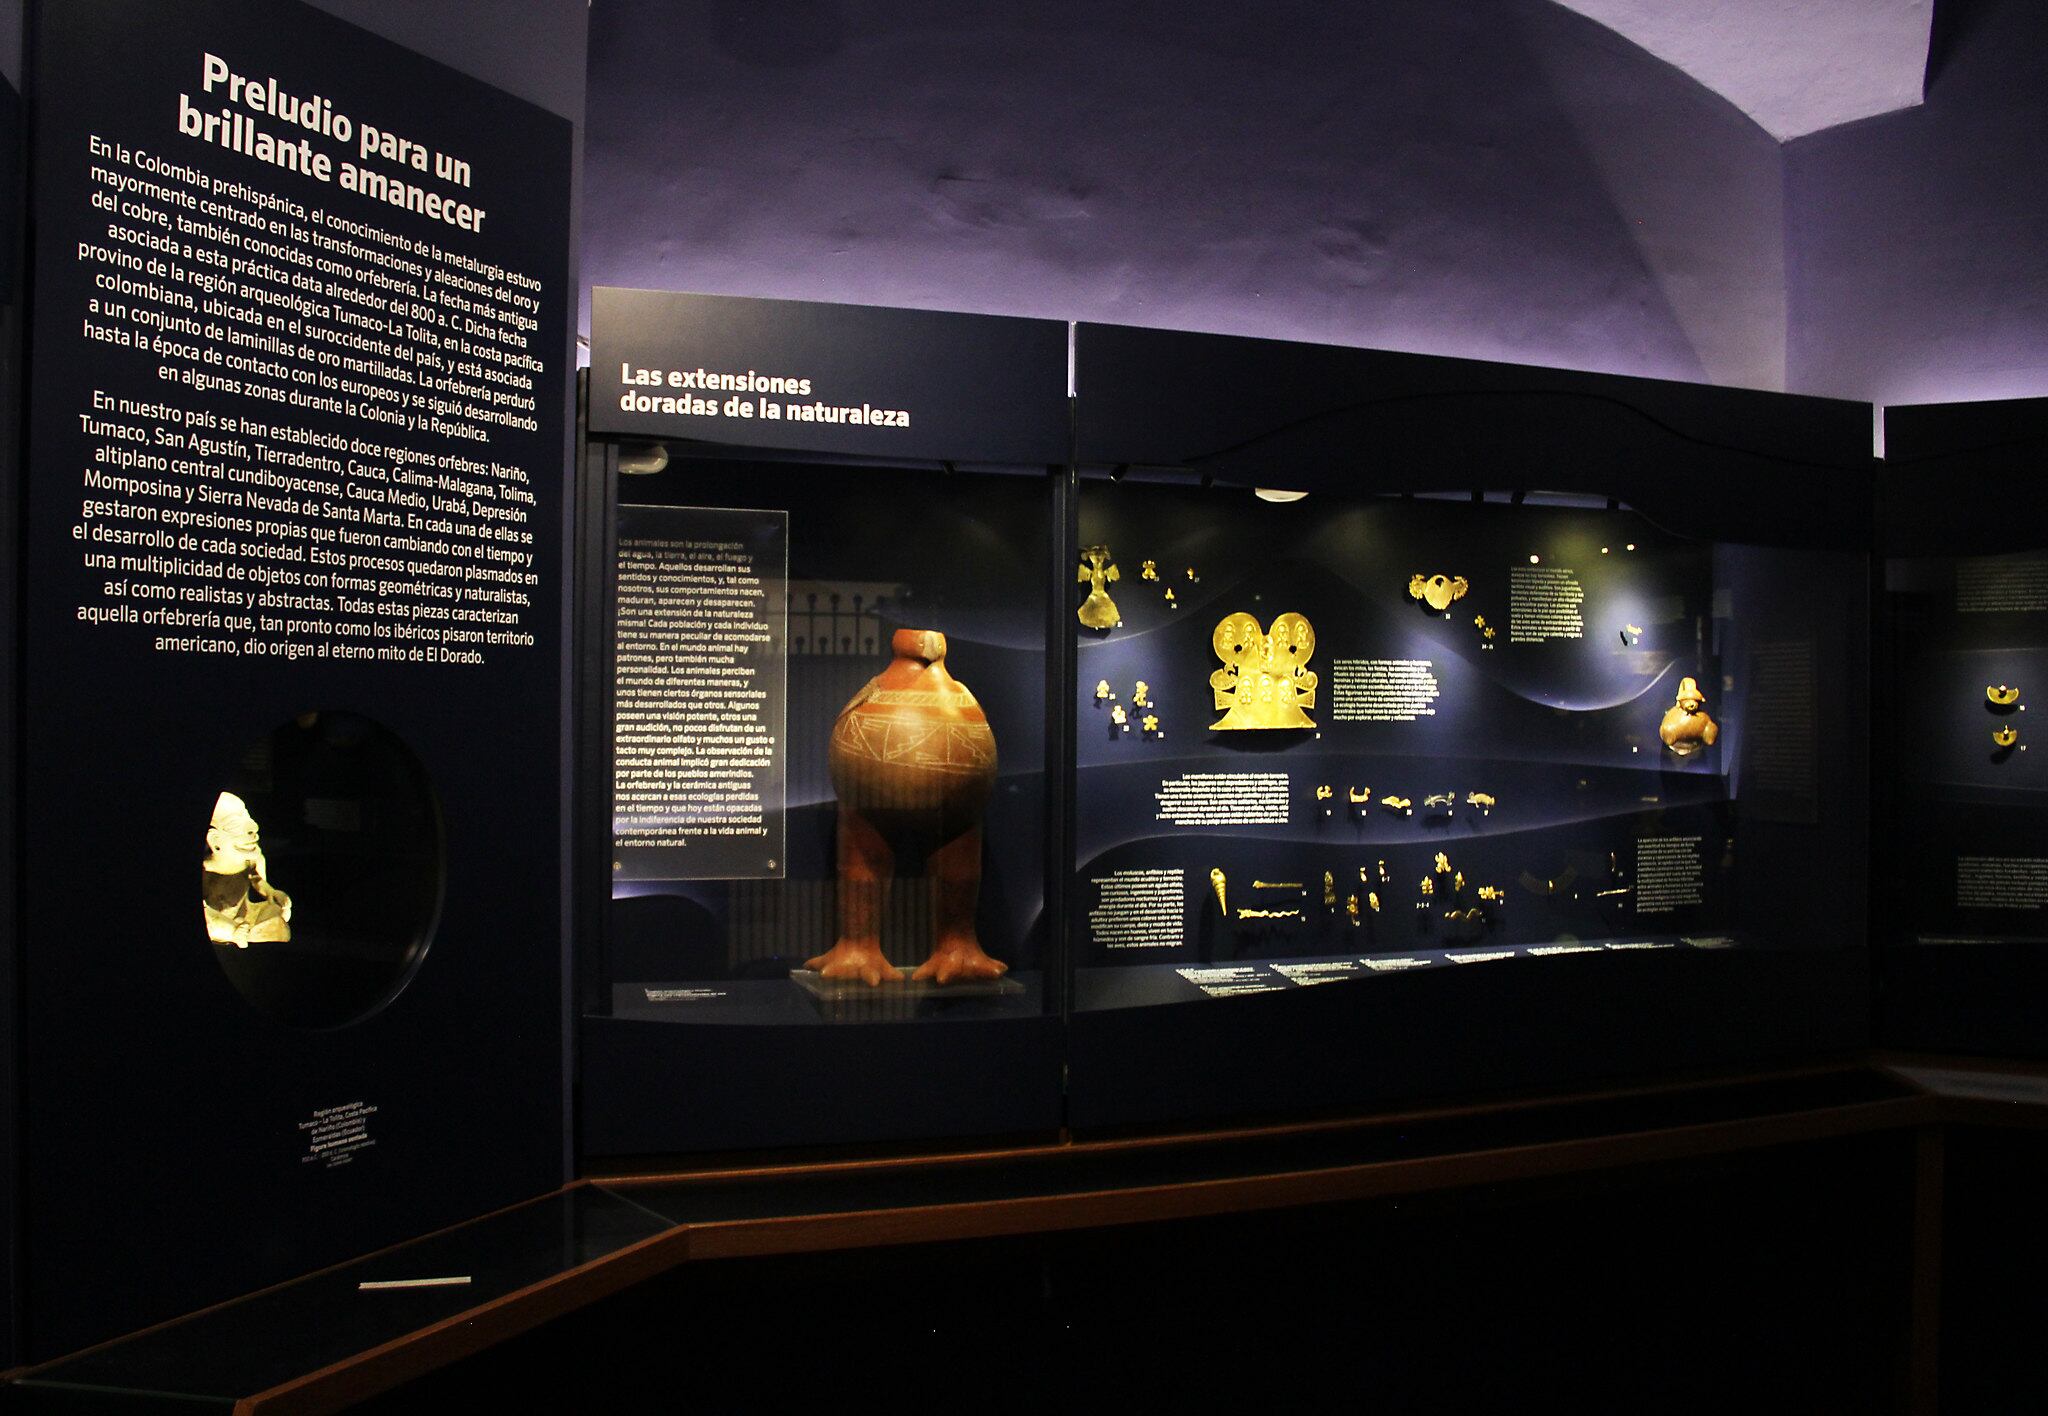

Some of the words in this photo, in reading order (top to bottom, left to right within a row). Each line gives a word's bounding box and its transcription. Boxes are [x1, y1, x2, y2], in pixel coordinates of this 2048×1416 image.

[179, 93, 331, 181] brillante
[339, 162, 485, 233] amanecer
[203, 52, 352, 142] Preludio
[360, 123, 427, 171] para
[435, 152, 470, 187] un
[90, 134, 111, 158] En
[116, 143, 130, 164] la
[134, 150, 209, 188] Colombia
[213, 178, 307, 222] prehispánica,
[311, 208, 323, 224] el
[326, 215, 411, 251] conocimiento
[413, 240, 429, 257] de
[431, 244, 441, 261] la
[444, 252, 504, 281] metalurgia
[506, 271, 541, 291] estuvo
[108, 224, 178, 255] asociada
[183, 244, 191, 258] a
[196, 248, 227, 268] esta
[232, 257, 288, 284] práctica
[291, 271, 322, 293] data
[325, 281, 387, 310] alrededor
[389, 298, 408, 316] del
[410, 303, 435, 323] 800
[437, 314, 448, 327] a.
[451, 314, 462, 331] C.
[465, 317, 495, 340] Dicha
[497, 327, 527, 348] fecha
[89, 298, 98, 313] a
[104, 301, 125, 319] un
[131, 308, 201, 335] conjunto
[204, 322, 223, 340] de
[227, 326, 294, 357] laminillas
[297, 343, 315, 361] de
[317, 351, 340, 367] oro
[343, 356, 415, 384] martilladas.
[419, 370, 432, 387] La
[435, 377, 491, 401] orfebrería
[493, 391, 535, 410] perduró
[621, 362, 662, 386] Las
[667, 368, 811, 395] extensiones
[93, 389, 114, 410] En
[119, 399, 181, 422] nuestro
[185, 410, 216, 428] país
[220, 417, 236, 432] se
[240, 416, 267, 437] han
[270, 425, 348, 451] establecido
[350, 437, 381, 457] doce
[384, 446, 435, 466] regiones
[437, 454, 488, 475] orfebres:
[491, 462, 529, 485] Nariño,
[620, 391, 718, 416] doradas
[723, 397, 753, 418] de
[759, 398, 780, 419] la
[786, 402, 909, 427] naturaleza
[72, 521, 87, 539] el
[92, 523, 174, 548] desarrollo
[178, 532, 197, 550] de
[201, 537, 236, 554] cada
[240, 542, 306, 562] sociedad.
[310, 546, 346, 566] Estos
[349, 555, 404, 572] procesos
[407, 560, 462, 577] quedaron
[465, 564, 523, 583] plasmados
[524, 573, 538, 585] en
[155, 635, 239, 656] americano,
[244, 637, 266, 654] dio
[269, 639, 314, 660] origen
[317, 641, 328, 657] al
[332, 643, 374, 659] eterno
[377, 645, 406, 660] mito
[408, 646, 423, 661] de
[426, 646, 437, 661] El
[440, 647, 484, 664] Dorado.
